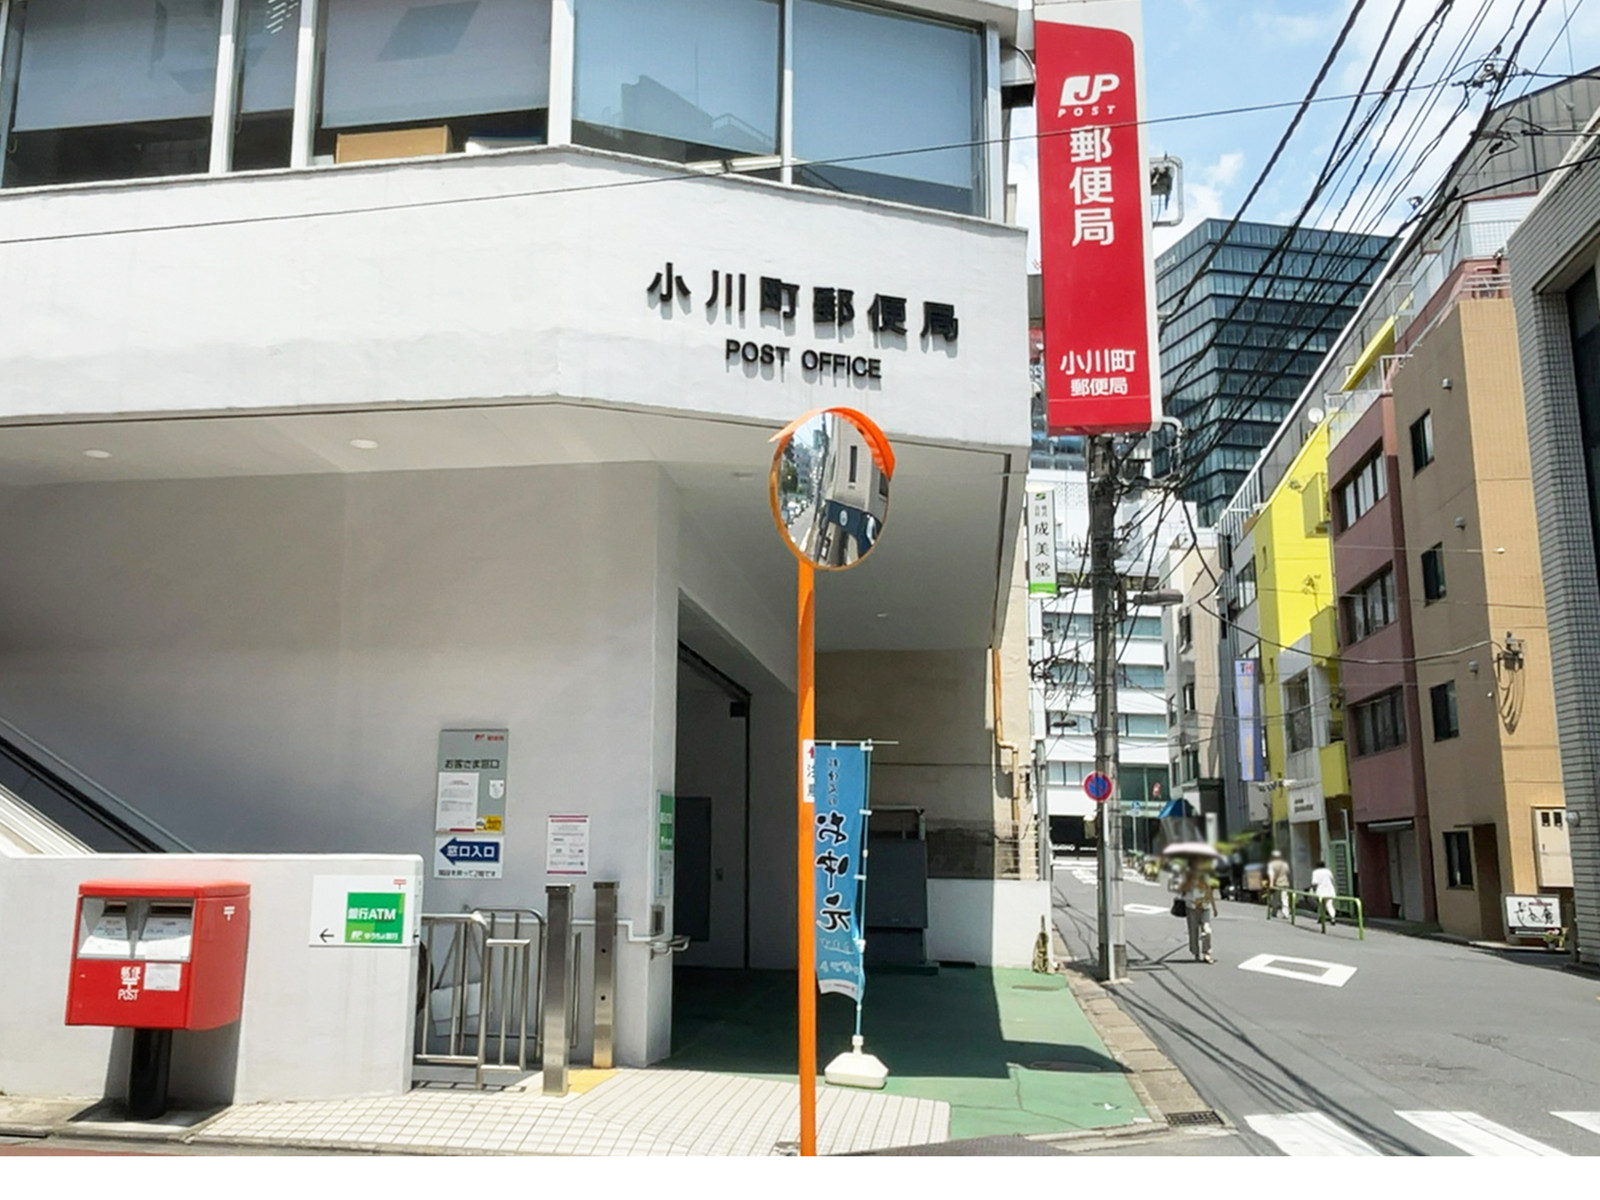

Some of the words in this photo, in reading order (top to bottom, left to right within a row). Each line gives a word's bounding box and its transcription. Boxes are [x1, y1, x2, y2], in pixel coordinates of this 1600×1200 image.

[1057, 105, 1116, 118] POST
[1069, 125, 1115, 247] 郵便局
[646, 262, 959, 342] 小川町郵便局
[725, 338, 790, 367] POST
[801, 349, 882, 379] OFFICE
[1060, 348, 1136, 375] 小川町
[1070, 377, 1128, 397] 郵便局
[1033, 521, 1051, 578] 成美堂
[446, 845, 495, 858] 窓口入口
[118, 989, 139, 1001] POST
